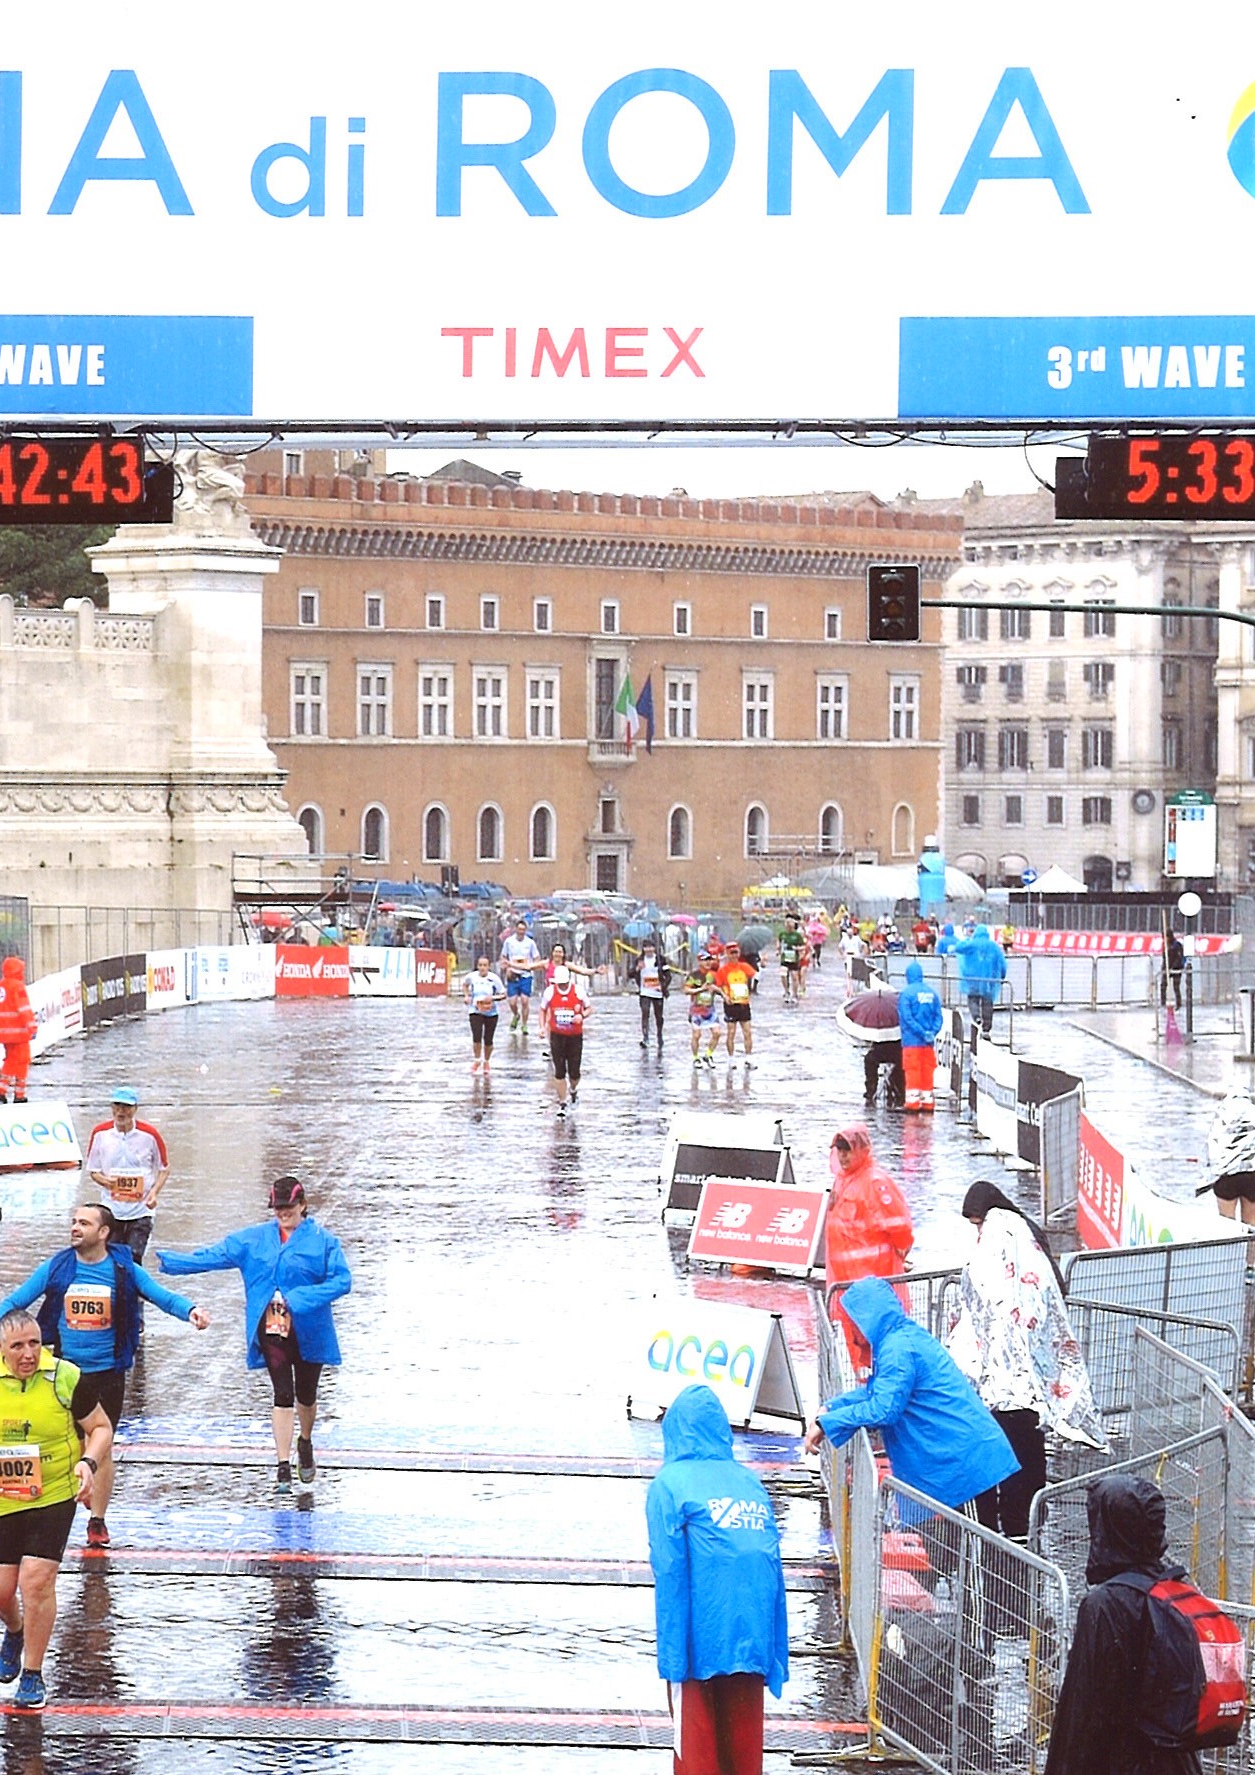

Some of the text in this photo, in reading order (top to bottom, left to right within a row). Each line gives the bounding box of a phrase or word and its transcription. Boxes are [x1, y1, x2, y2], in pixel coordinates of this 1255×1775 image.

[250, 116, 366, 217] di
[436, 67, 1092, 218] ROMA
[441, 327, 706, 378] TIMEX
[1048, 345, 1245, 389] 3rd WAVE
[282, 963, 312, 978] HONDA
[117, 1177, 138, 1188] 1937
[698, 1228, 751, 1242] new balance
[755, 1234, 809, 1248] new balance
[71, 1300, 104, 1315] 9763
[647, 1329, 756, 1388] acea
